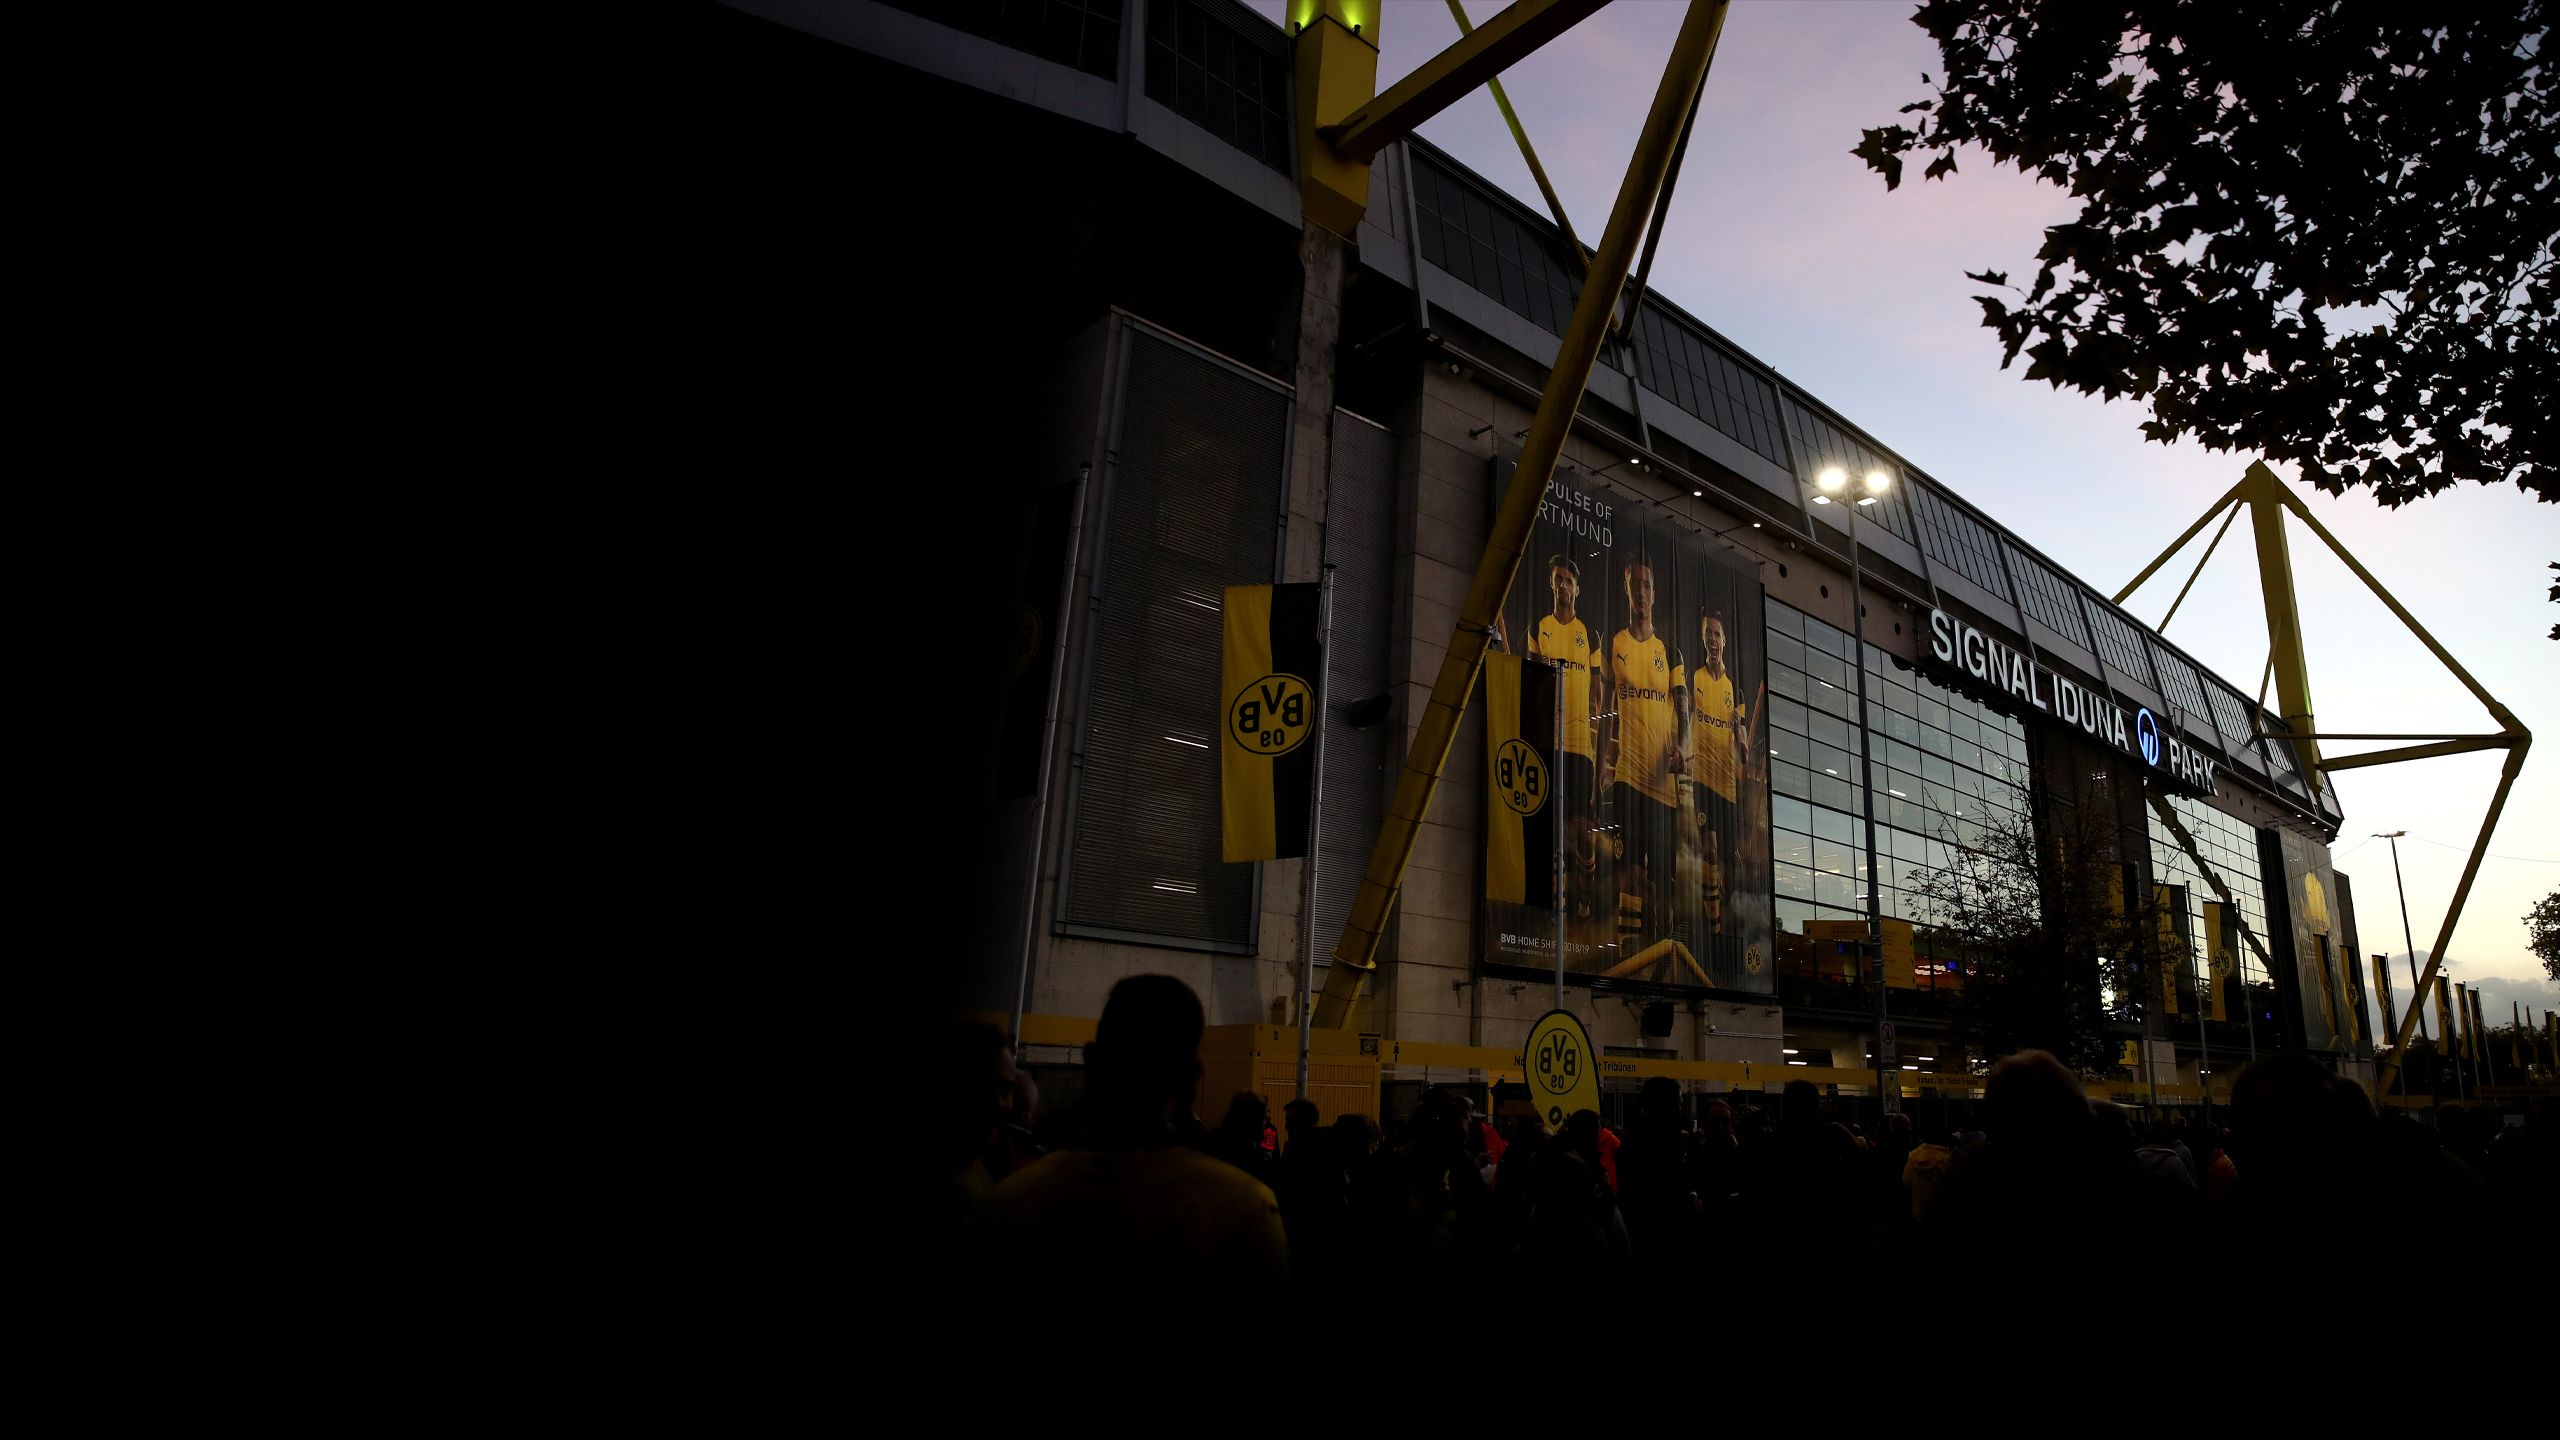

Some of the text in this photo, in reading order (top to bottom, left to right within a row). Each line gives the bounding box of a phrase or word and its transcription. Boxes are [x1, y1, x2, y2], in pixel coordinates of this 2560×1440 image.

[1546, 479, 1613, 521] PULSE OF
[1537, 499, 1613, 548] RTMUND
[1930, 608, 2219, 797] SIGNAL IDUNA PARK
[1501, 933, 1516, 944] BVB
[1517, 936, 1539, 948] HOME
[1563, 942, 1590, 954] 2018/19
[1604, 1061, 1636, 1073] Tribünen
